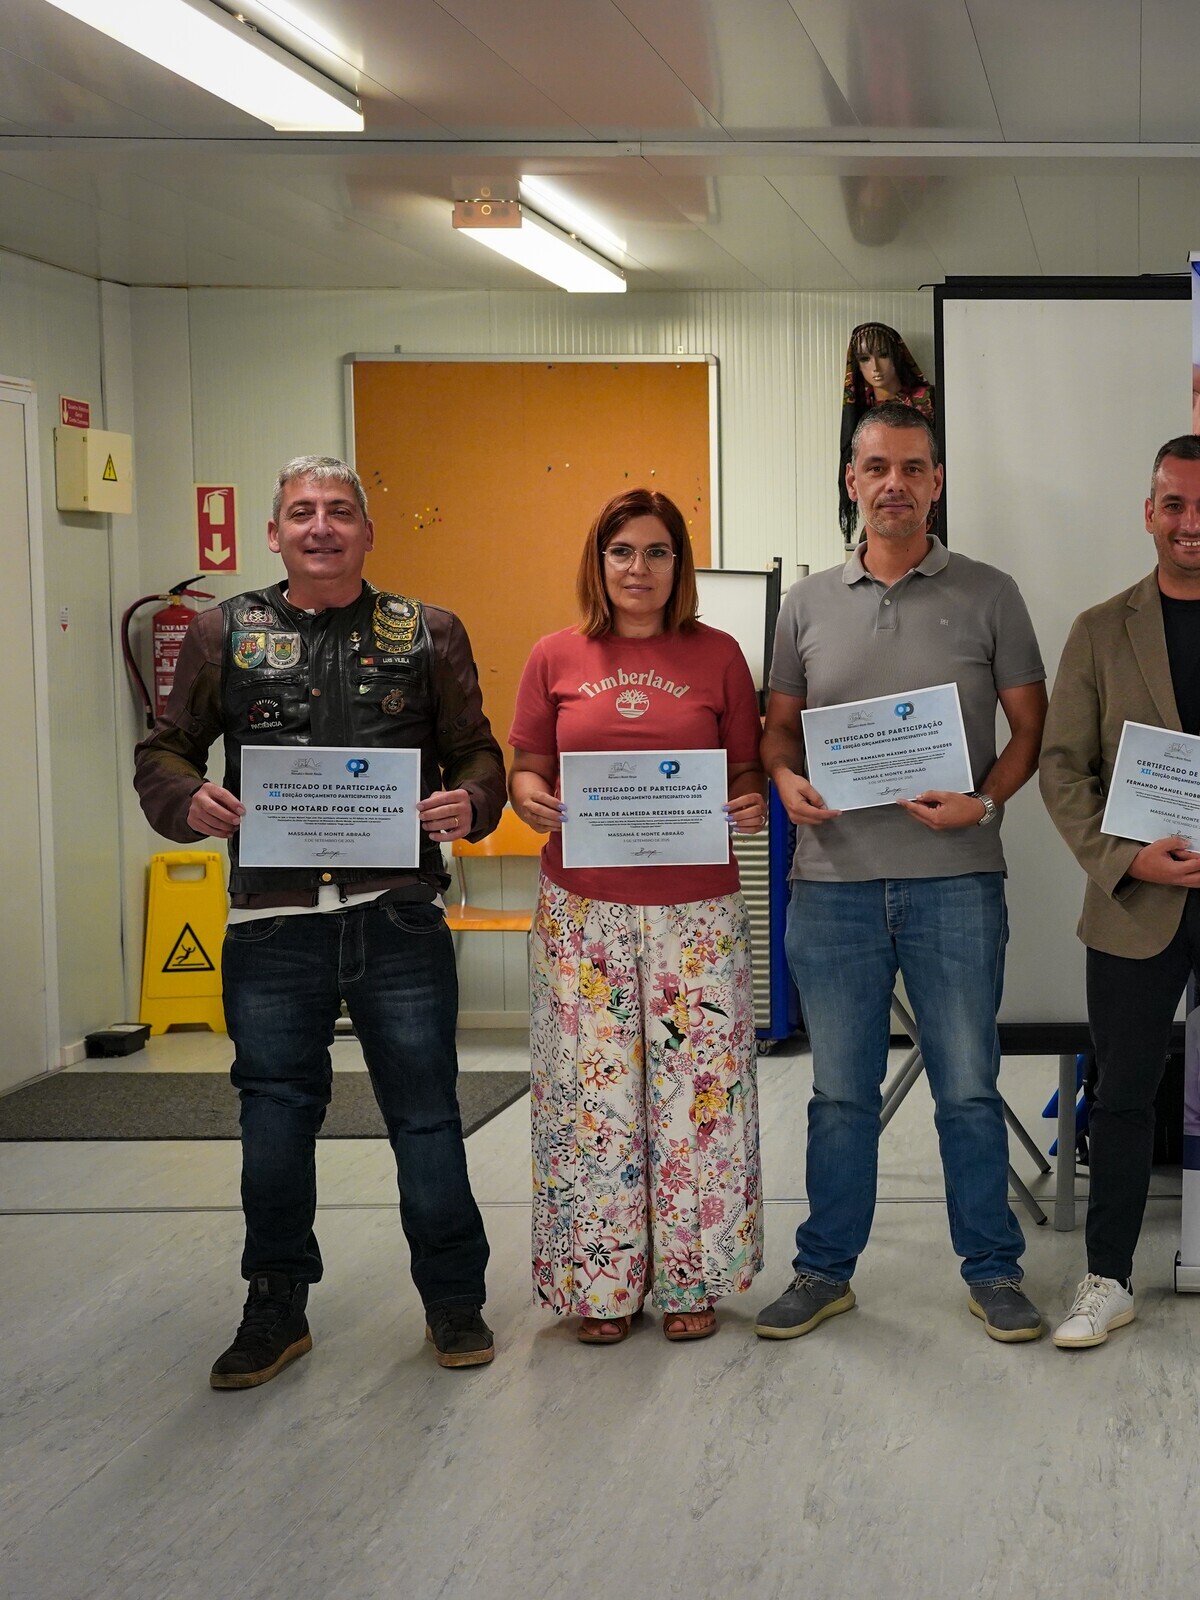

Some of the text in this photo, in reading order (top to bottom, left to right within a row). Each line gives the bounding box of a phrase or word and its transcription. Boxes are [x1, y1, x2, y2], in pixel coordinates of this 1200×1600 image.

[577, 668, 691, 698] Timberland
[250, 721, 283, 729] PACIÊNCIA
[825, 733, 874, 745] CERTIFICADO
[888, 721, 942, 735] PARTICIPAÇÃO
[1137, 760, 1186, 774] CERTIFICADO
[1171, 776, 1200, 785] ORÇAMENTO
[336, 784, 397, 792] PARTICIPAÇÃO
[650, 784, 707, 792] PARTICIPAÇÃO
